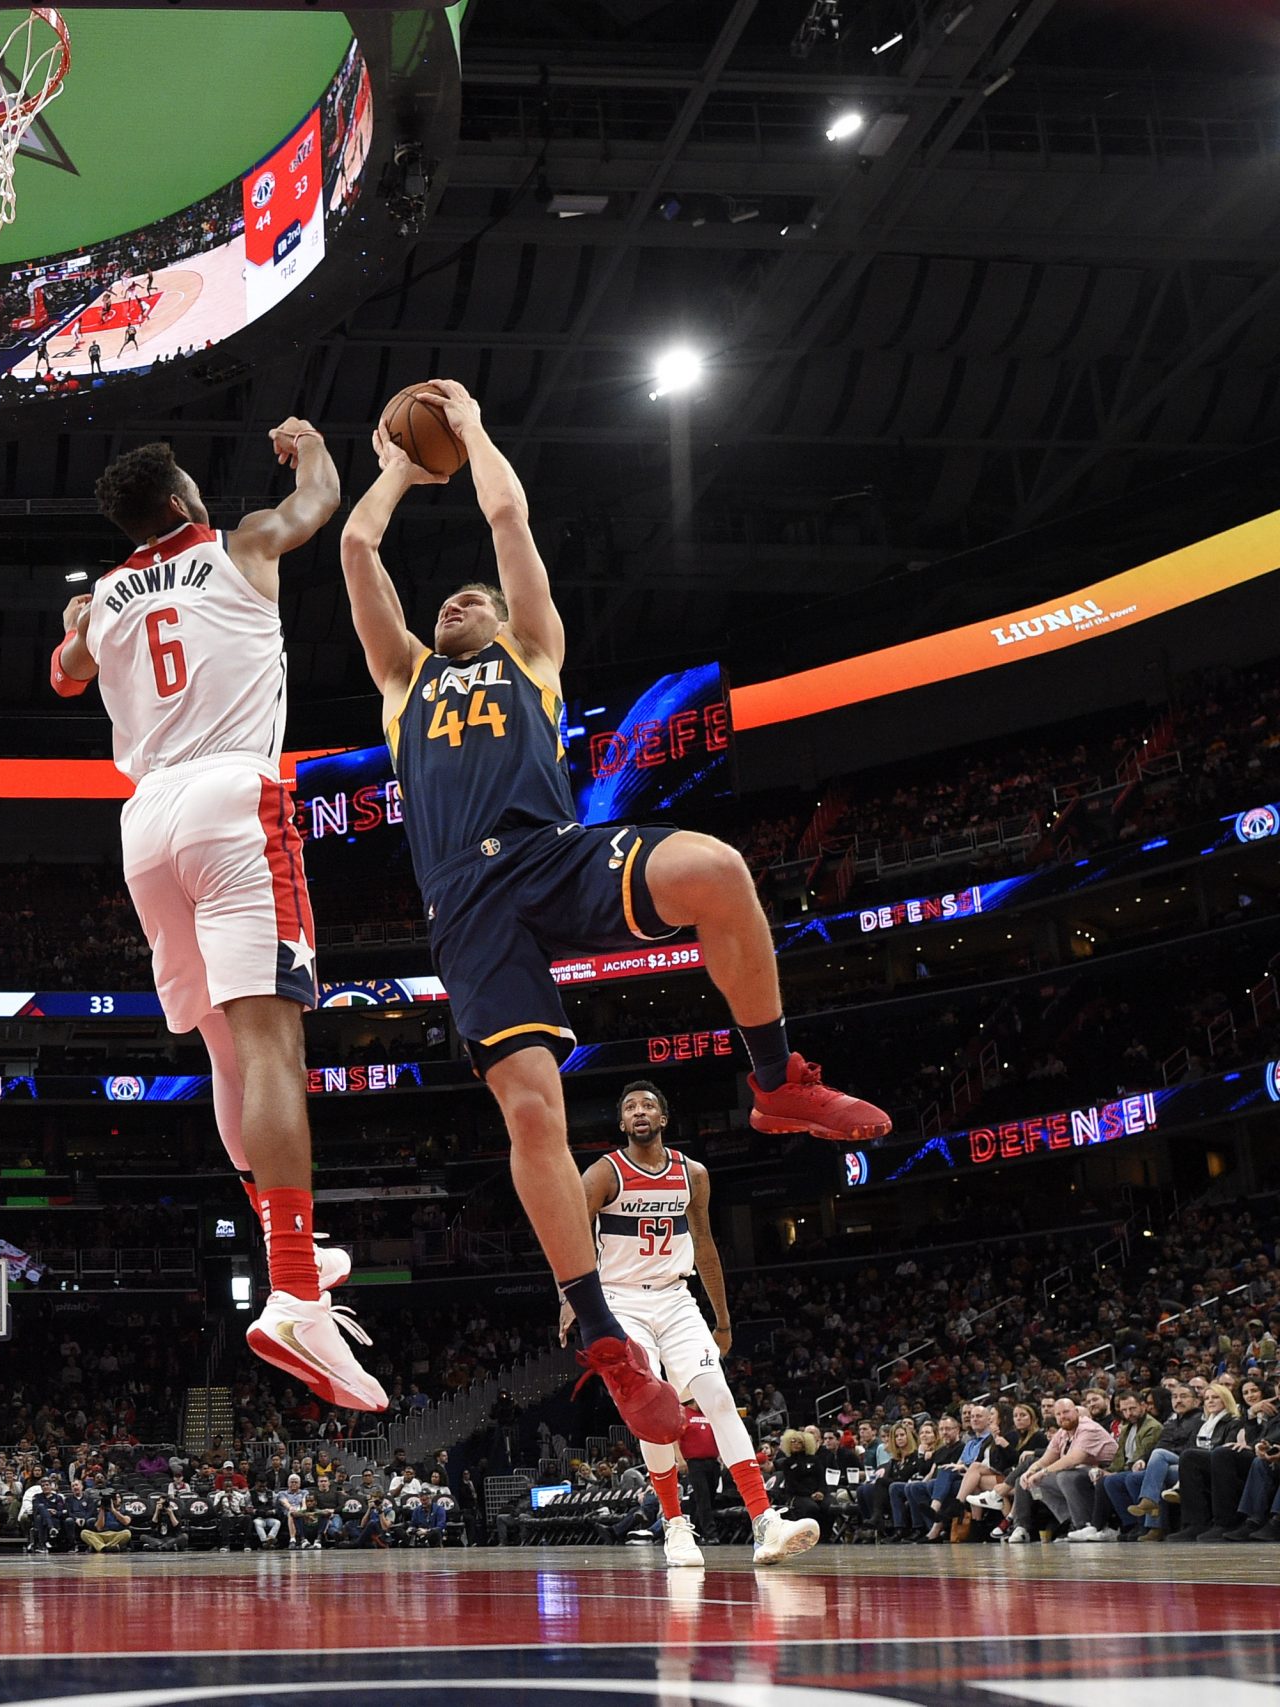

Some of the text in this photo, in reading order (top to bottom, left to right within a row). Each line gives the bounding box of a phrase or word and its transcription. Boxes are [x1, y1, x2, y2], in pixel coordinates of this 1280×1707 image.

[295, 176, 308, 199] 33
[256, 210, 271, 231] 44
[287, 224, 301, 244] 2nd
[105, 559, 213, 614] BROWN JR.
[1075, 605, 1137, 631] Feel the Power
[145, 607, 187, 697] 6
[427, 690, 507, 747] 44
[602, 959, 646, 972] JACKPOT:
[647, 949, 699, 968] $2,395
[90, 996, 114, 1013] 33
[648, 1030, 732, 1062] DEFE
[970, 1092, 1157, 1163] DEFENSE!
[621, 1196, 685, 1212] wizards
[639, 1218, 672, 1255] 52
[700, 1349, 714, 1366] dc
